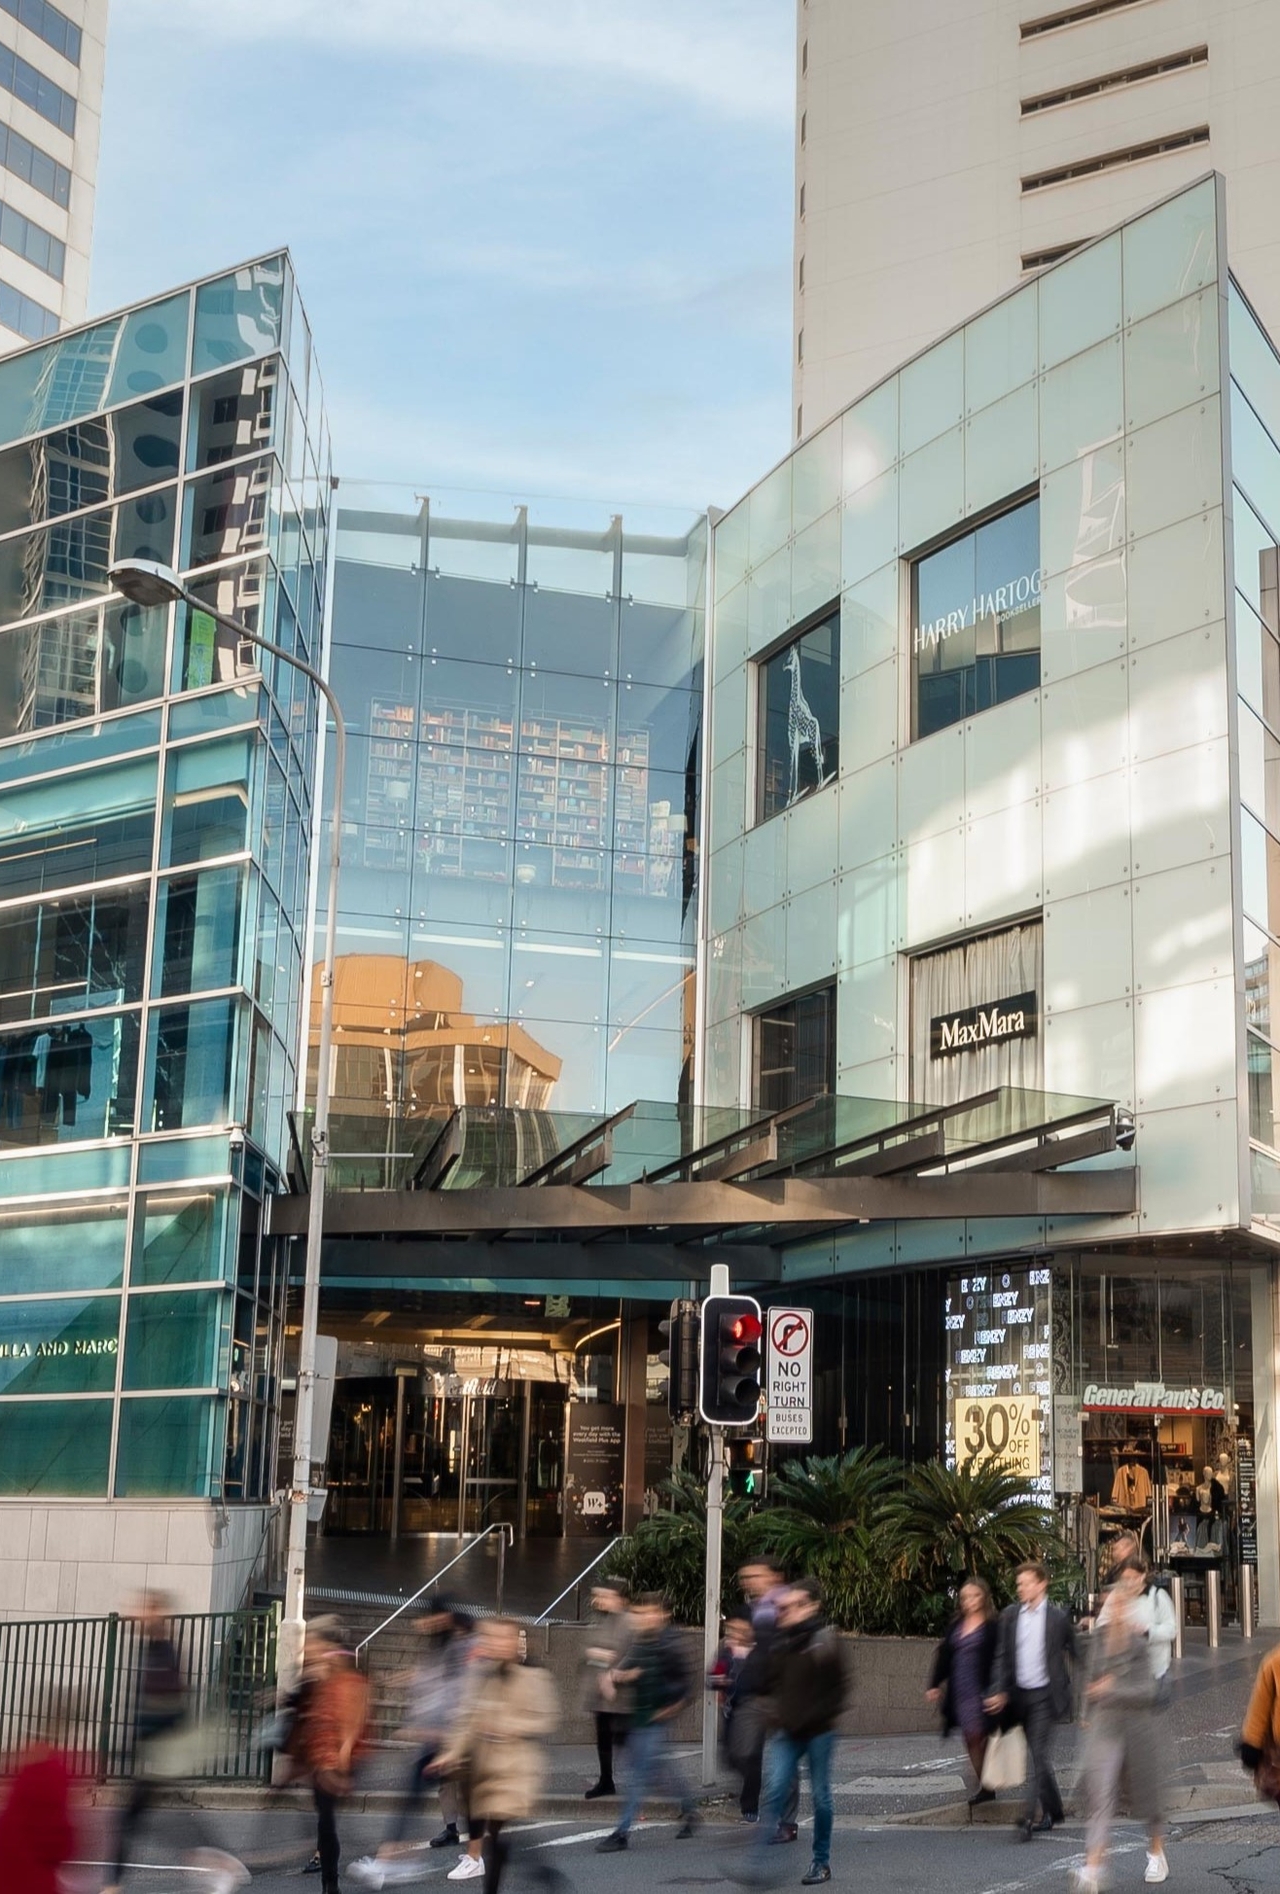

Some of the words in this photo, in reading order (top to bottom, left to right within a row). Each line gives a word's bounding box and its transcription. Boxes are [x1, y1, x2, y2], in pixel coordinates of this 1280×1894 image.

[914, 605, 968, 653] HARRY
[972, 567, 1041, 626] HARTOG
[939, 1007, 1025, 1050] MaxMara
[35, 1341, 69, 1356] AND
[74, 1338, 119, 1355] MARC
[778, 1361, 801, 1377] NO
[773, 1381, 806, 1393] RIGHT
[774, 1396, 805, 1407] TURN
[1083, 1384, 1154, 1406] General
[1151, 1388, 1200, 1409] Pants
[775, 1413, 803, 1423] BUSES
[771, 1427, 807, 1436] EXCEPTED
[964, 1403, 1030, 1455] 30%
[1009, 1439, 1030, 1453] OFF
[963, 1457, 1030, 1470] VEYTHING
